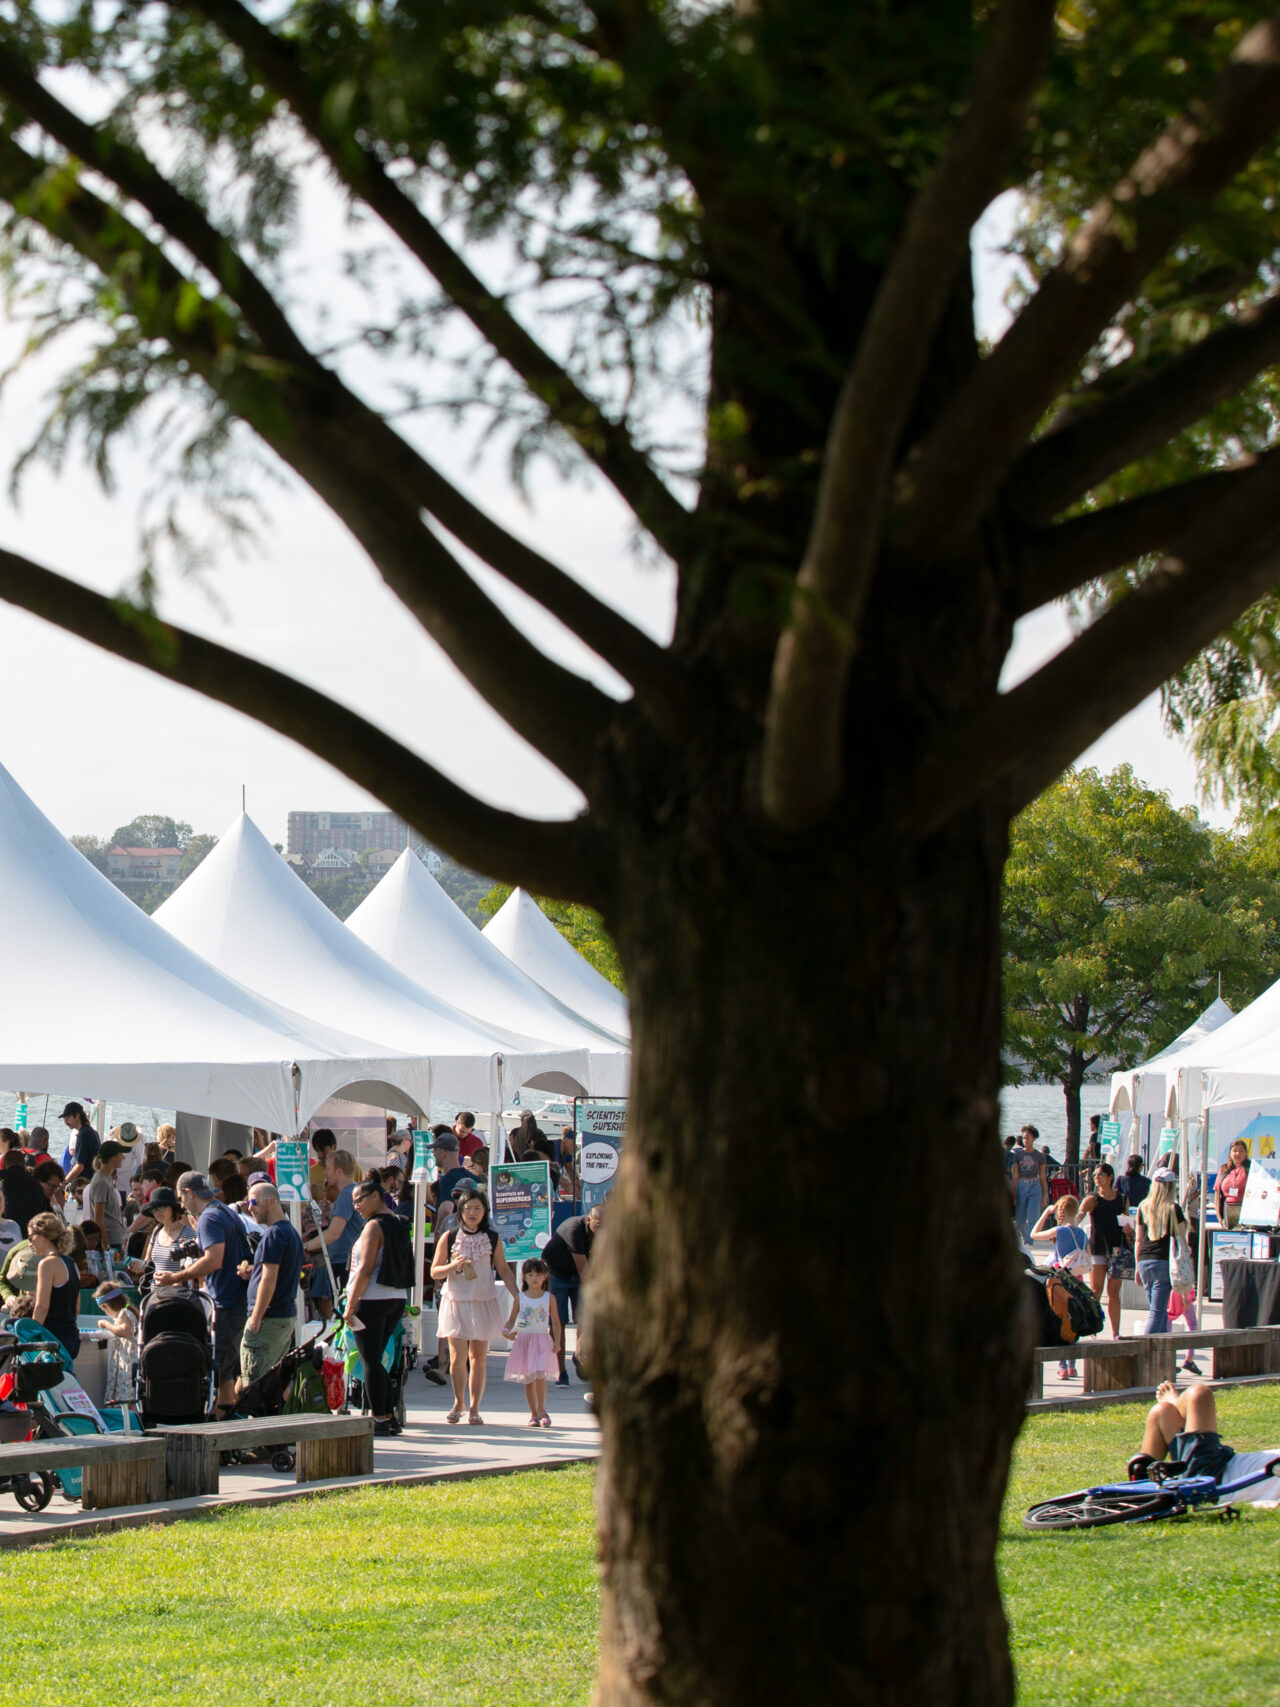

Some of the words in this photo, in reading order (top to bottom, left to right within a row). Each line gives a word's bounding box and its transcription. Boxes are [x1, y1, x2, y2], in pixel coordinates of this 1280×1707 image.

[586, 1110, 626, 1121] SCIENTIST
[592, 1121, 626, 1132] SUPERHE
[585, 1152, 614, 1160] EXPLORING
